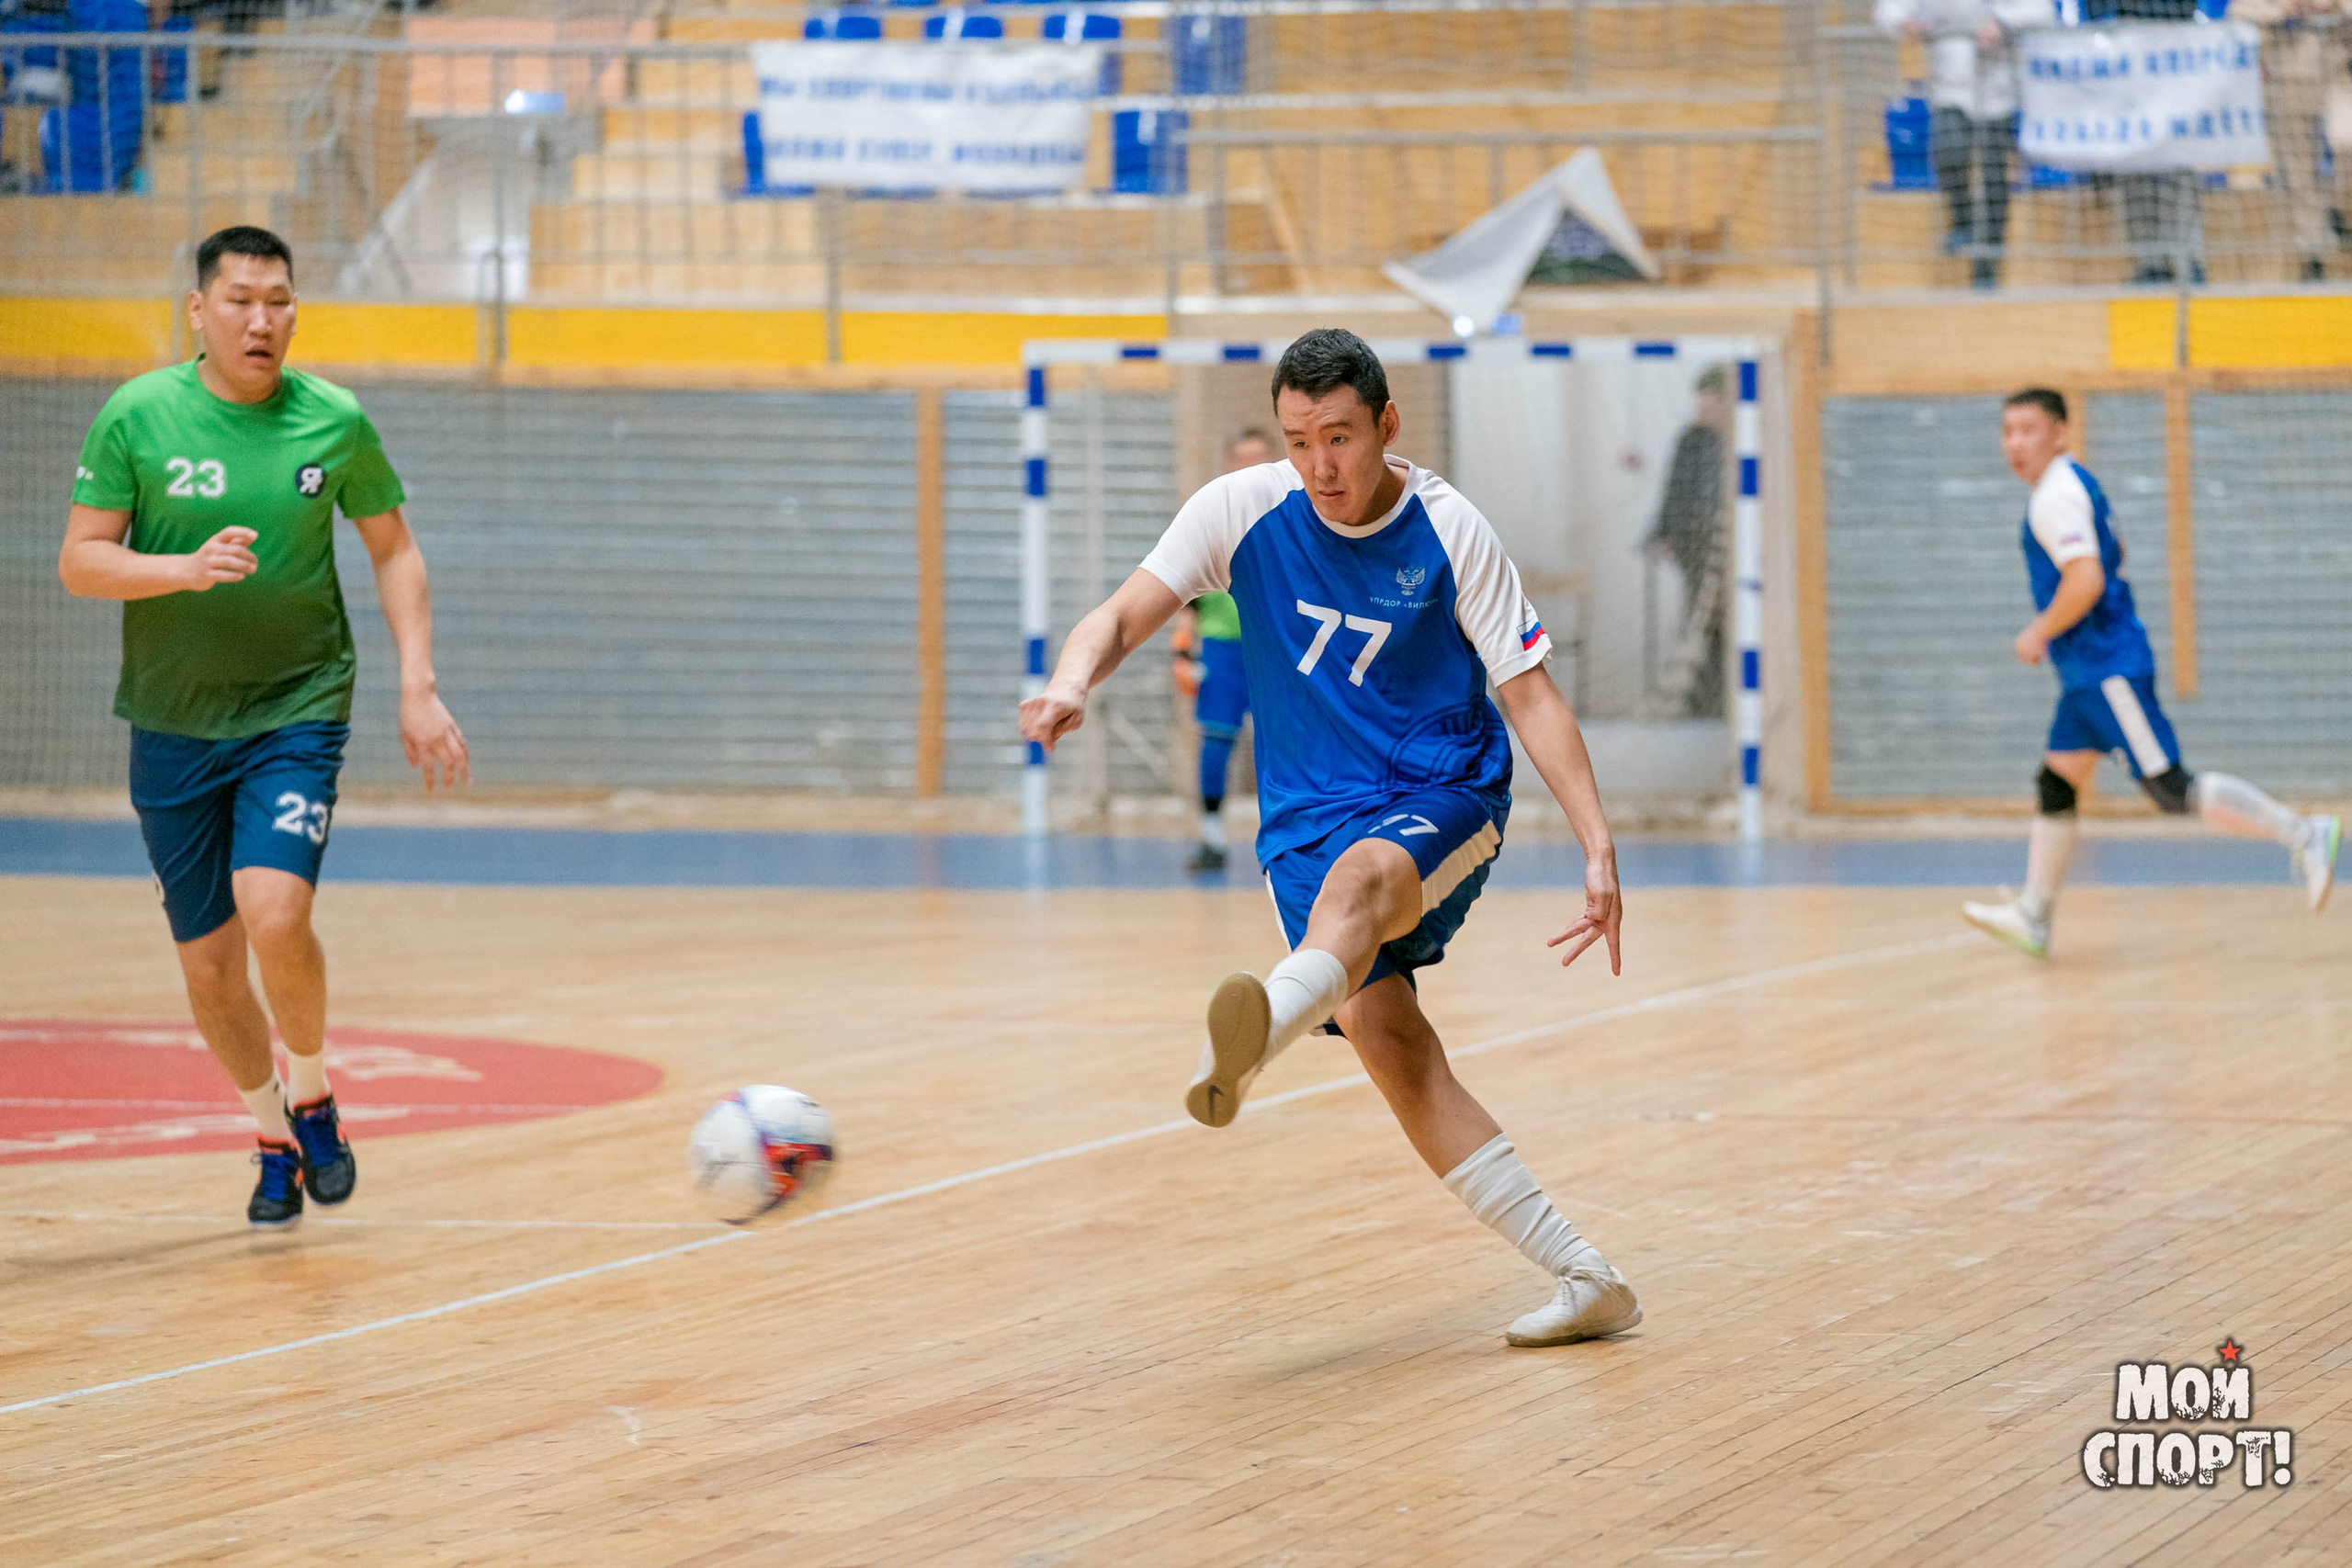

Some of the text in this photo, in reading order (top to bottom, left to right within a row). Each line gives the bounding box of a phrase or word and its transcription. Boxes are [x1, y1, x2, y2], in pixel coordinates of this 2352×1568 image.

[166, 457, 225, 497] 23
[1369, 596, 1401, 607] УПРДОР
[1296, 599, 1392, 687] 77
[272, 790, 328, 844] 23
